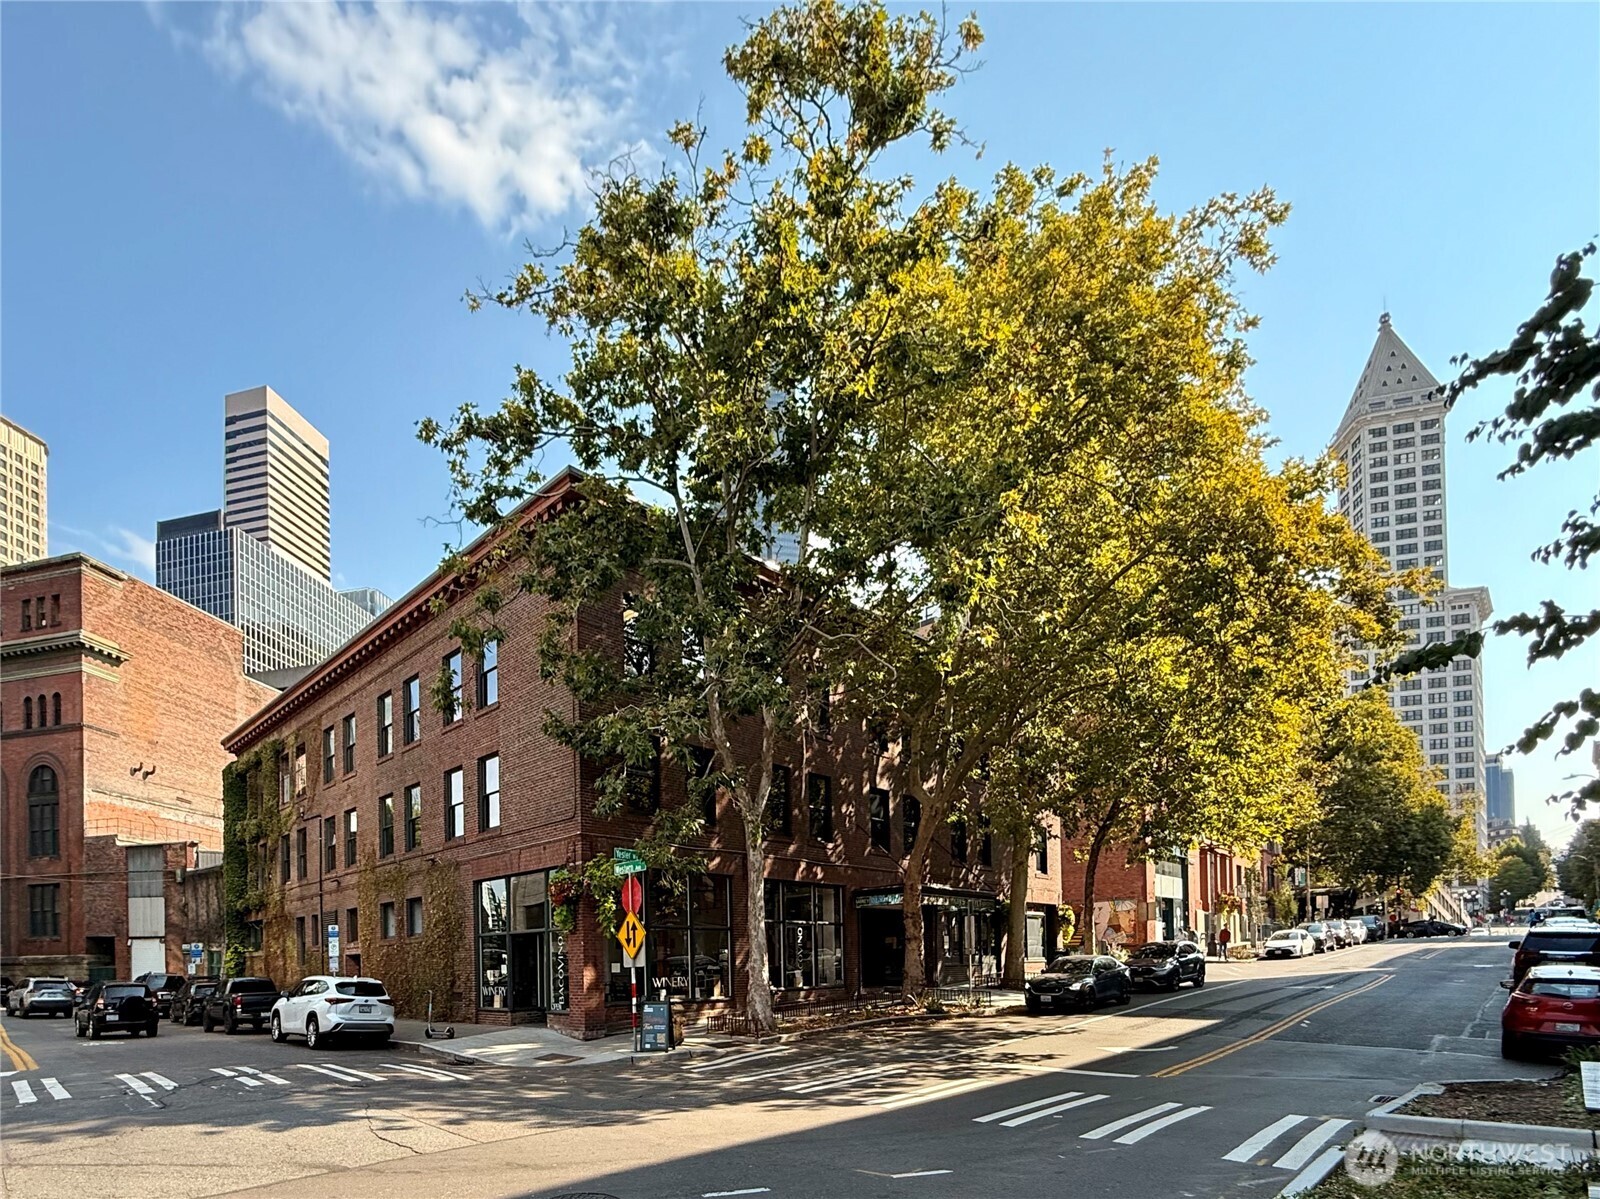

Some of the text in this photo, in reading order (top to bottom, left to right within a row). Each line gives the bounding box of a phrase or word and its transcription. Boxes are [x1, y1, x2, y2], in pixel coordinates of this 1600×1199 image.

[616, 850, 631, 859] Yesler
[652, 976, 689, 988] WINERY
[482, 986, 507, 997] WINERY
